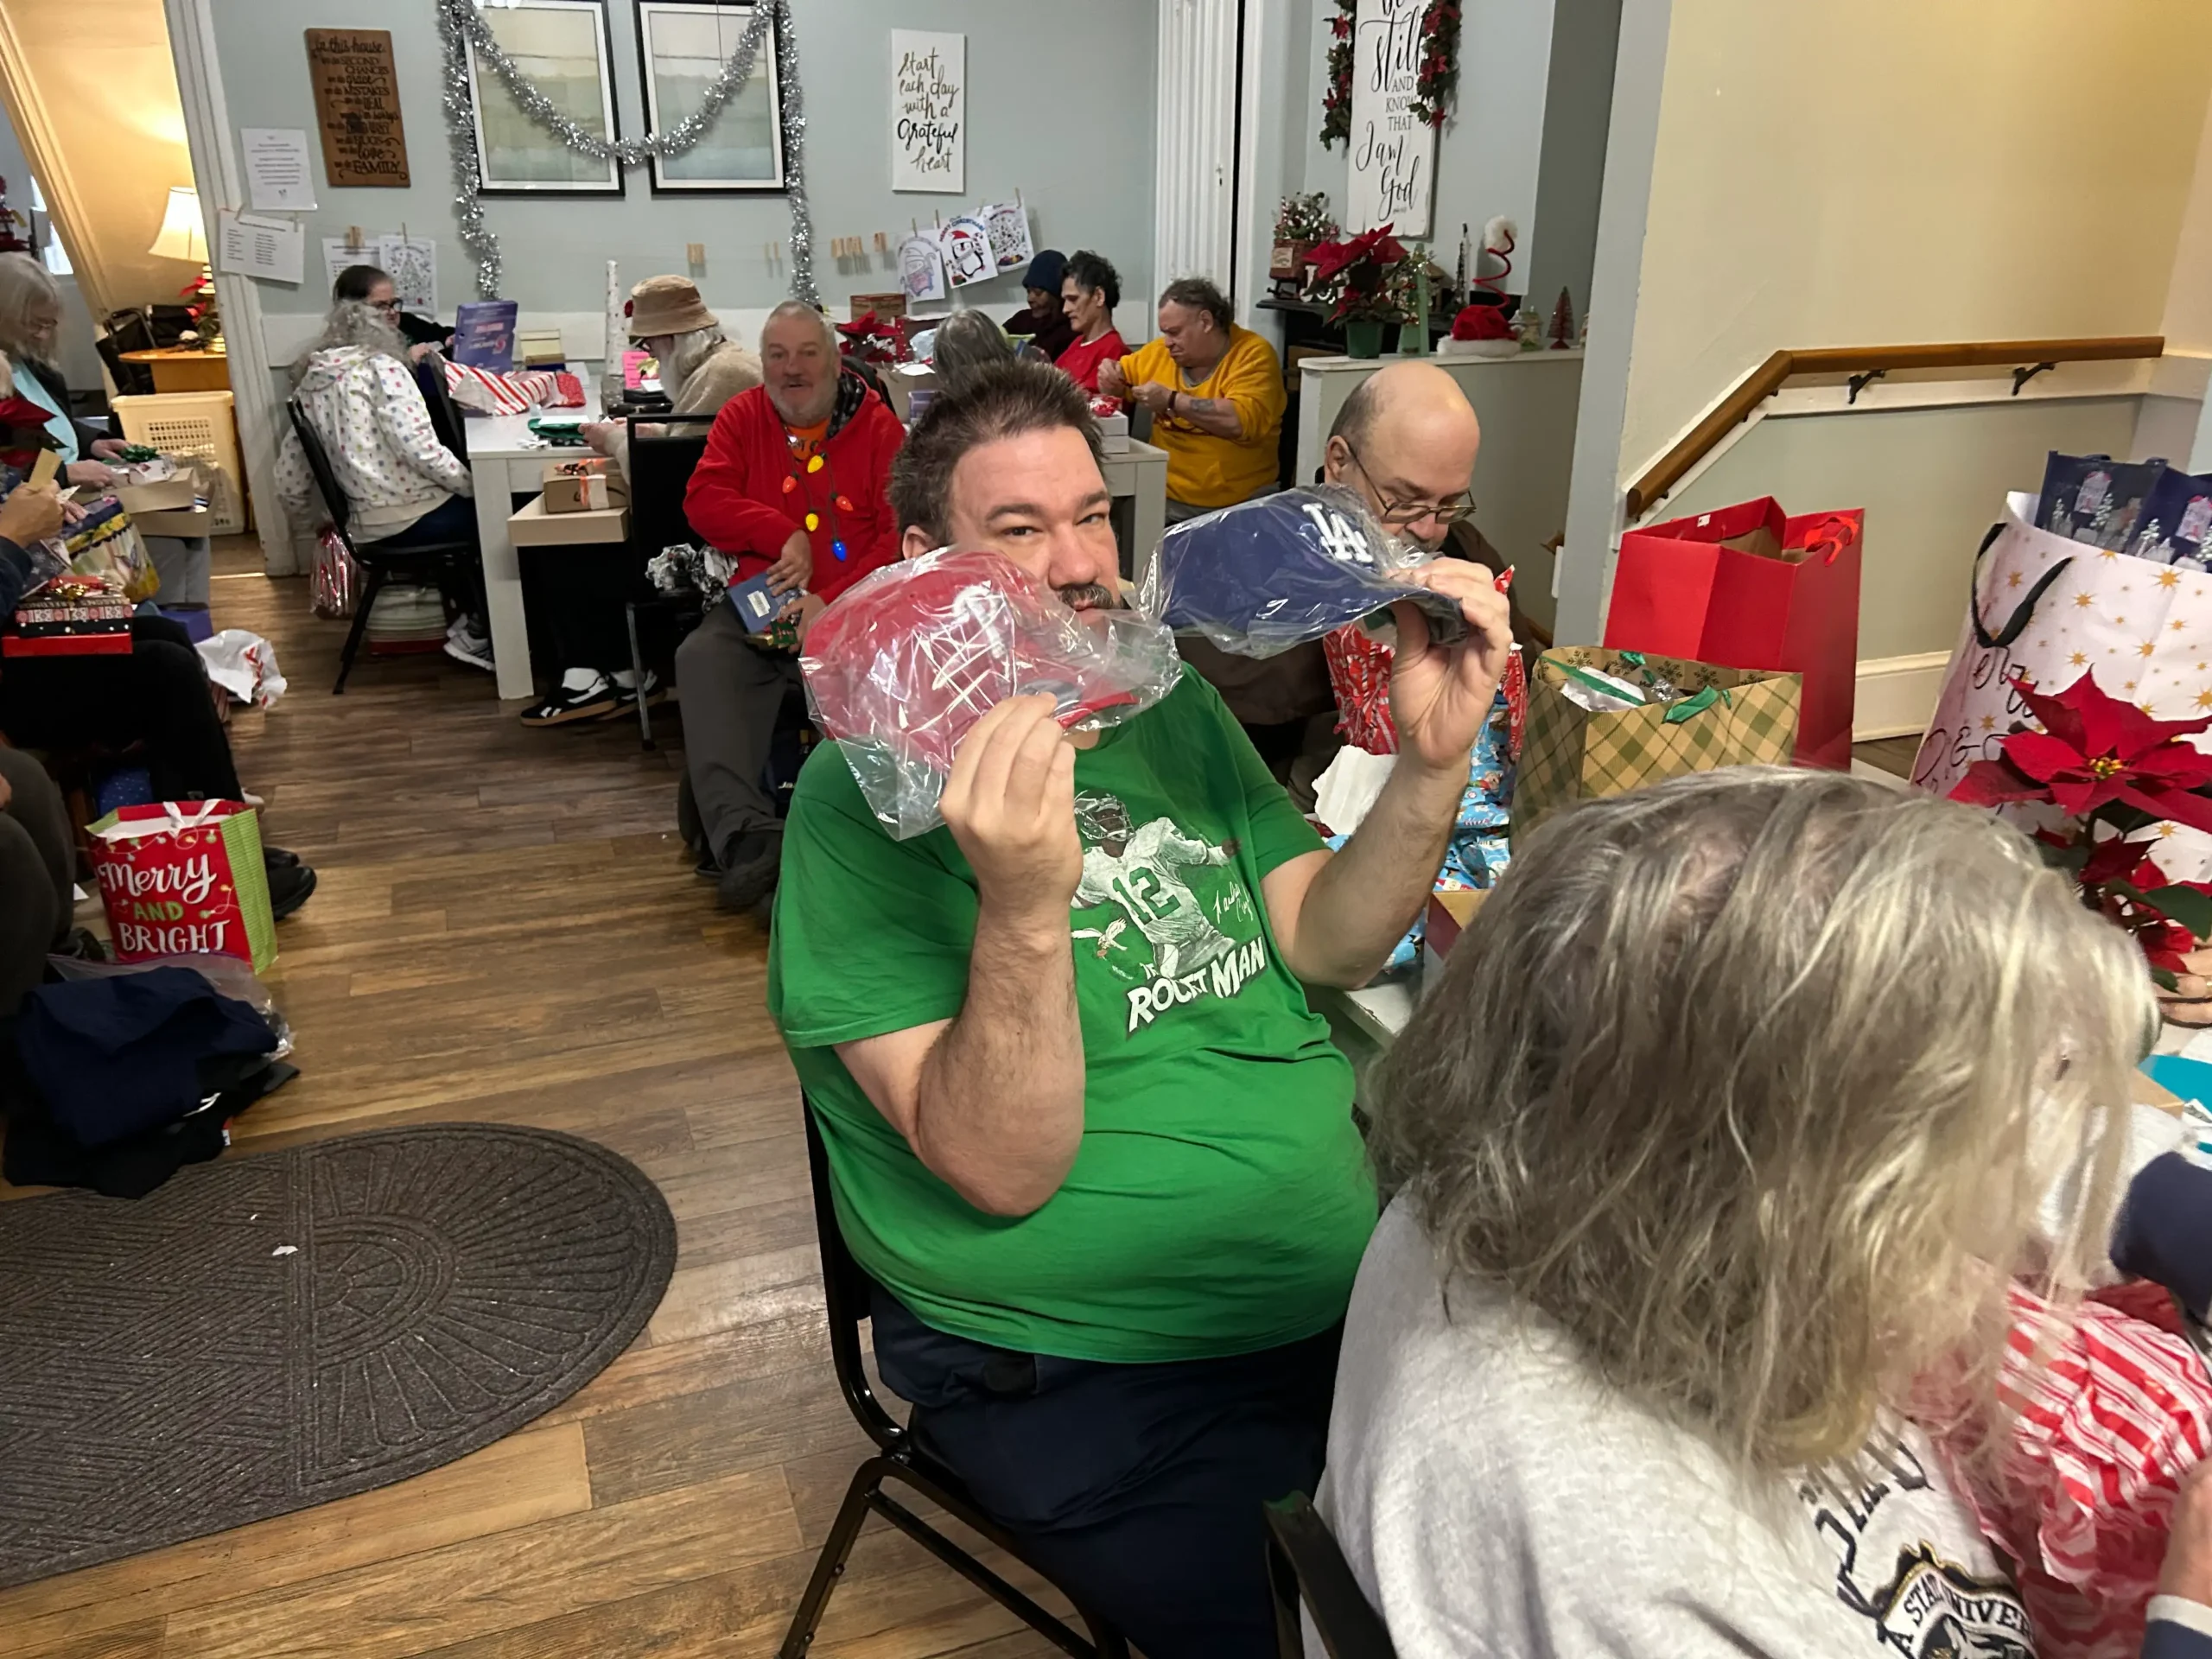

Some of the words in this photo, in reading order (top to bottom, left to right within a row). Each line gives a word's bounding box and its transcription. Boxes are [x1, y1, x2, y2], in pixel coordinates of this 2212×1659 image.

[899, 73, 925, 95] each
[931, 65, 959, 108] day
[1391, 76, 1414, 92] AND
[903, 92, 936, 119] with
[1386, 95, 1417, 112] KNOW
[1388, 115, 1413, 131] THAT
[353, 160, 401, 175] FAMILY
[910, 145, 953, 173] heart
[98, 853, 217, 905] Merry
[1112, 866, 1180, 925] 12
[133, 900, 184, 921] AND
[118, 918, 232, 954] BRIGHT
[1211, 936, 1266, 999] MAN
